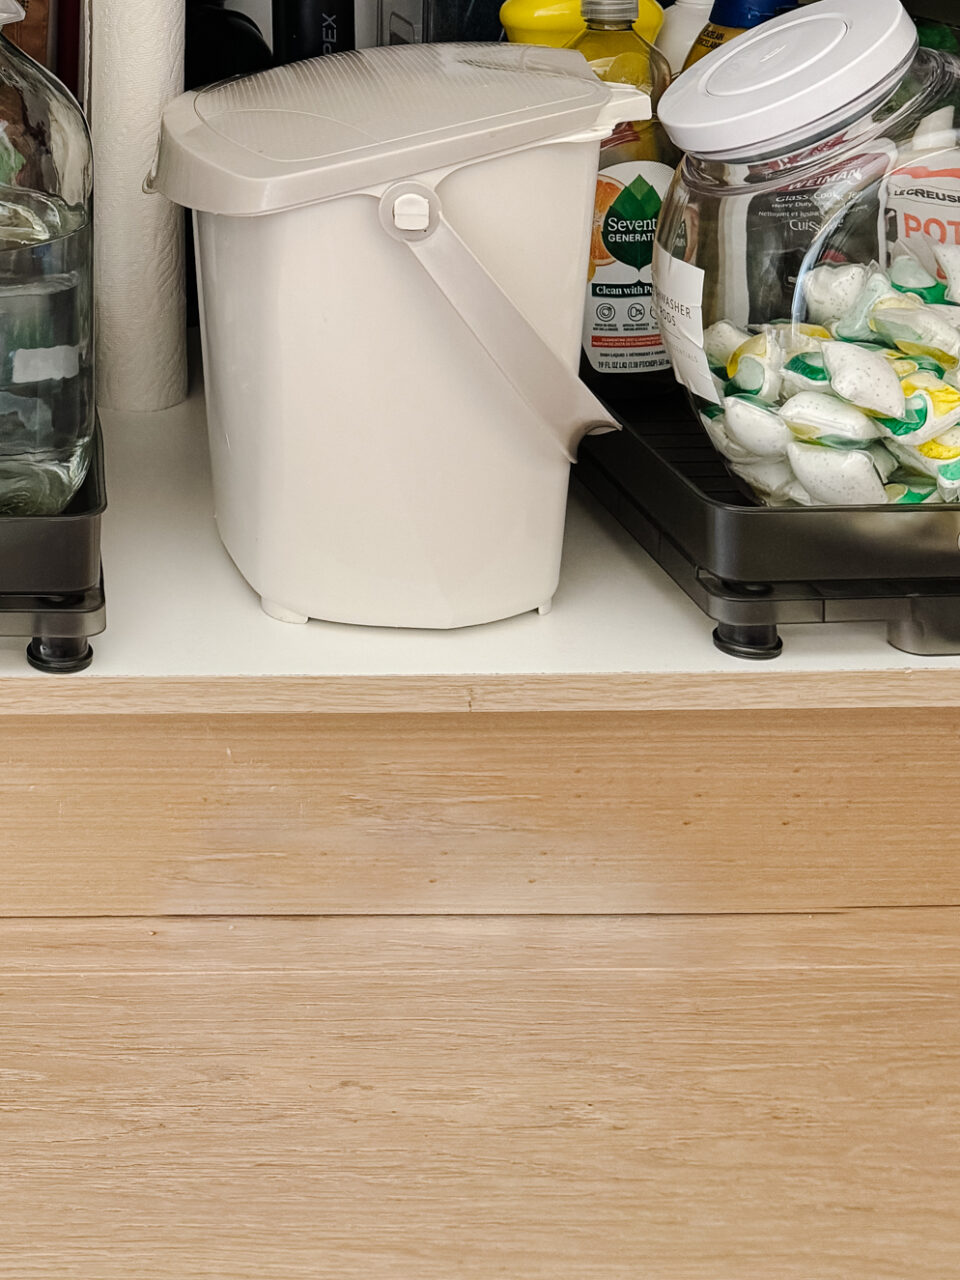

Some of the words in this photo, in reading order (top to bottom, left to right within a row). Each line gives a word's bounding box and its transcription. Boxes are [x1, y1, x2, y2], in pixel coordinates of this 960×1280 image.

[321, 12, 337, 56] PEX
[607, 217, 657, 232] Sevent
[607, 233, 655, 243] GENERATI
[596, 285, 622, 295] Clean
[623, 284, 643, 295] with
